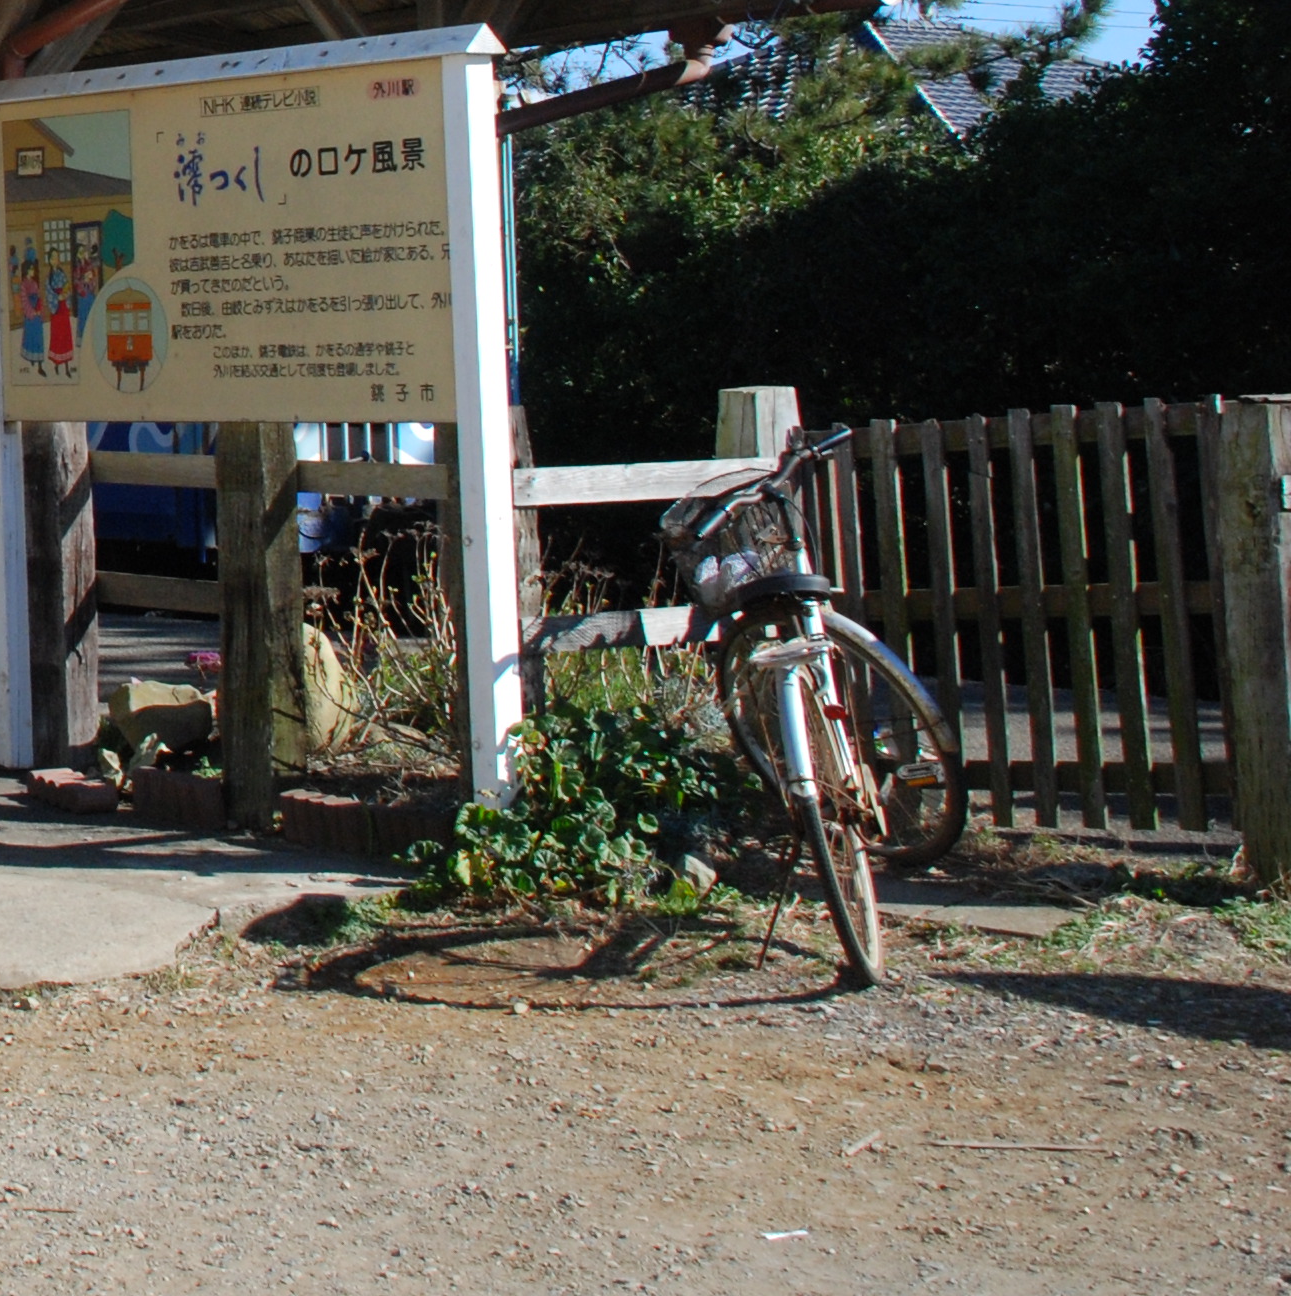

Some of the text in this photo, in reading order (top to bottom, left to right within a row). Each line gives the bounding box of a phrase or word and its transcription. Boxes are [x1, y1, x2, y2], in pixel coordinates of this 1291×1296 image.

[373, 79, 414, 99] 外川駅
[203, 88, 317, 115] NHK 連続テレビ小説
[370, 383, 435, 403] 銚子市
